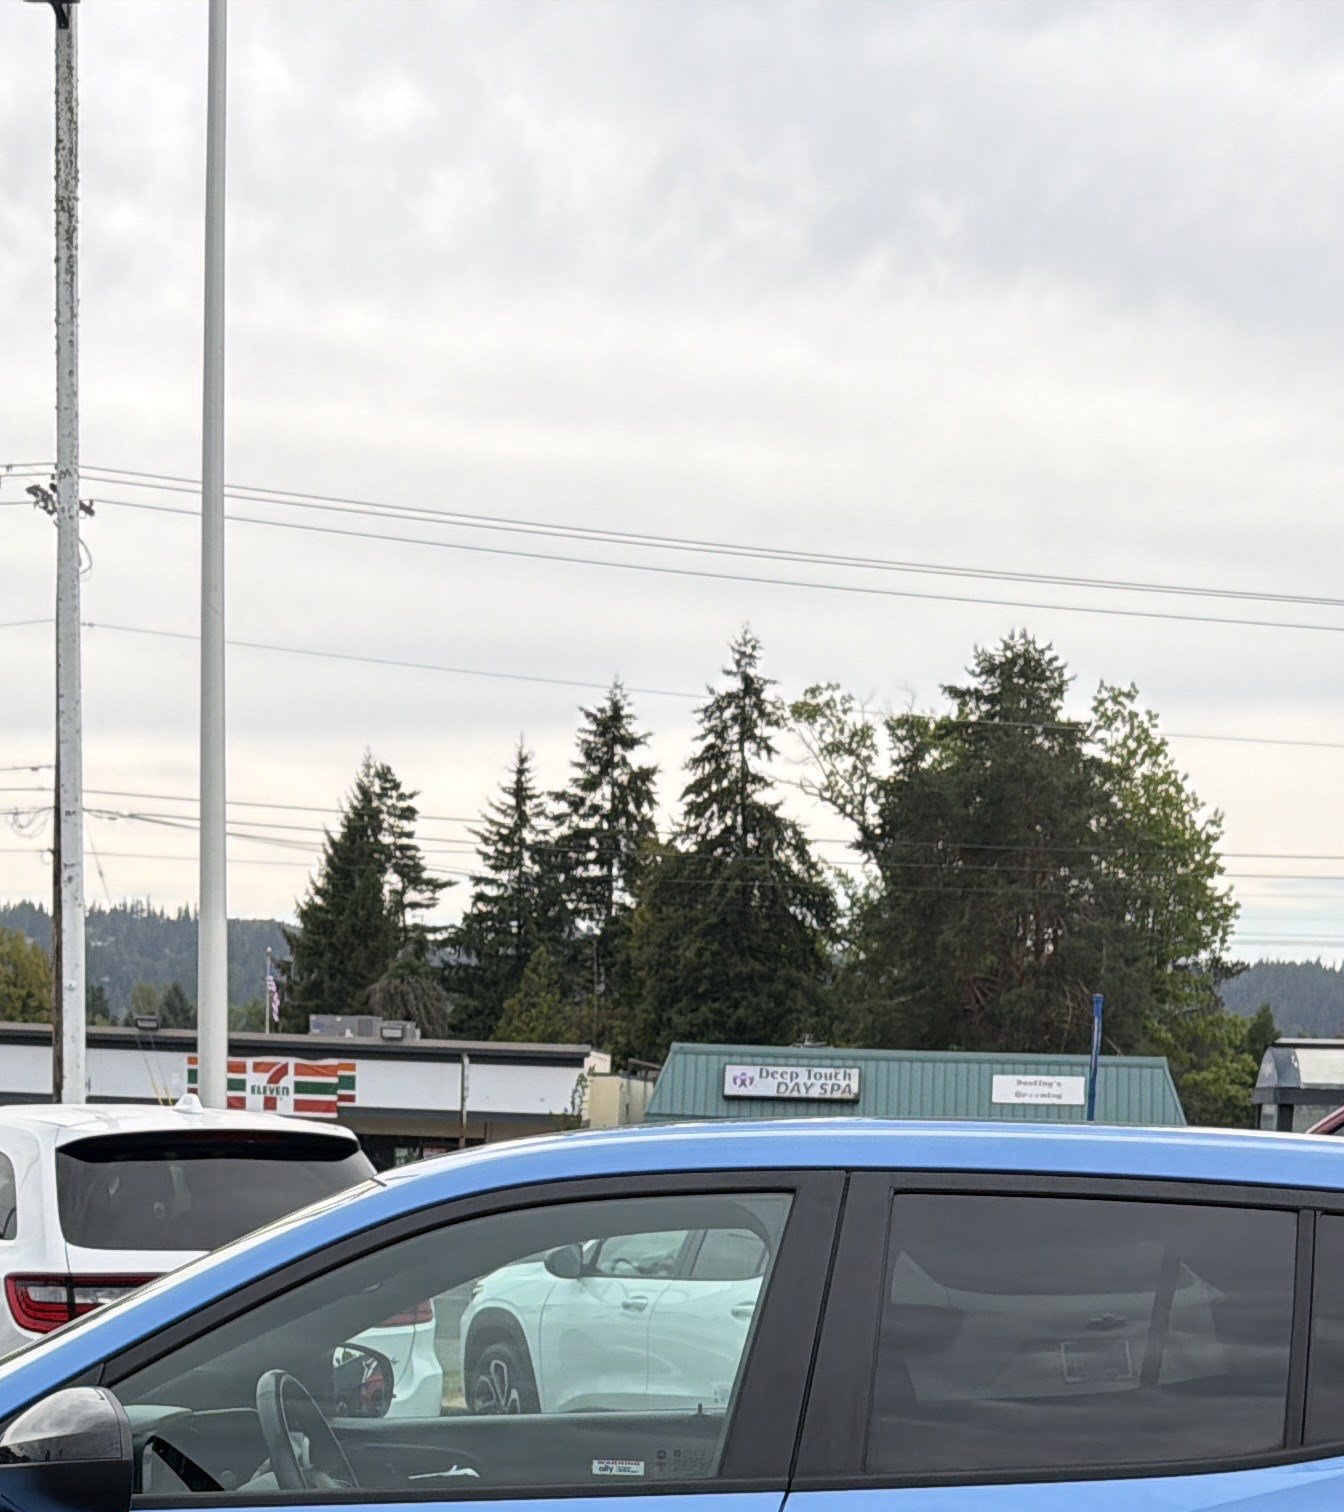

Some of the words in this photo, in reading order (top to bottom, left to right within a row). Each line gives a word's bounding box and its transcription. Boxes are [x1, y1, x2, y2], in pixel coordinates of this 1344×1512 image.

[759, 1067, 800, 1082] Deep
[804, 1068, 852, 1081] Touch
[776, 1082, 815, 1095] DAY
[819, 1082, 852, 1096] SPA
